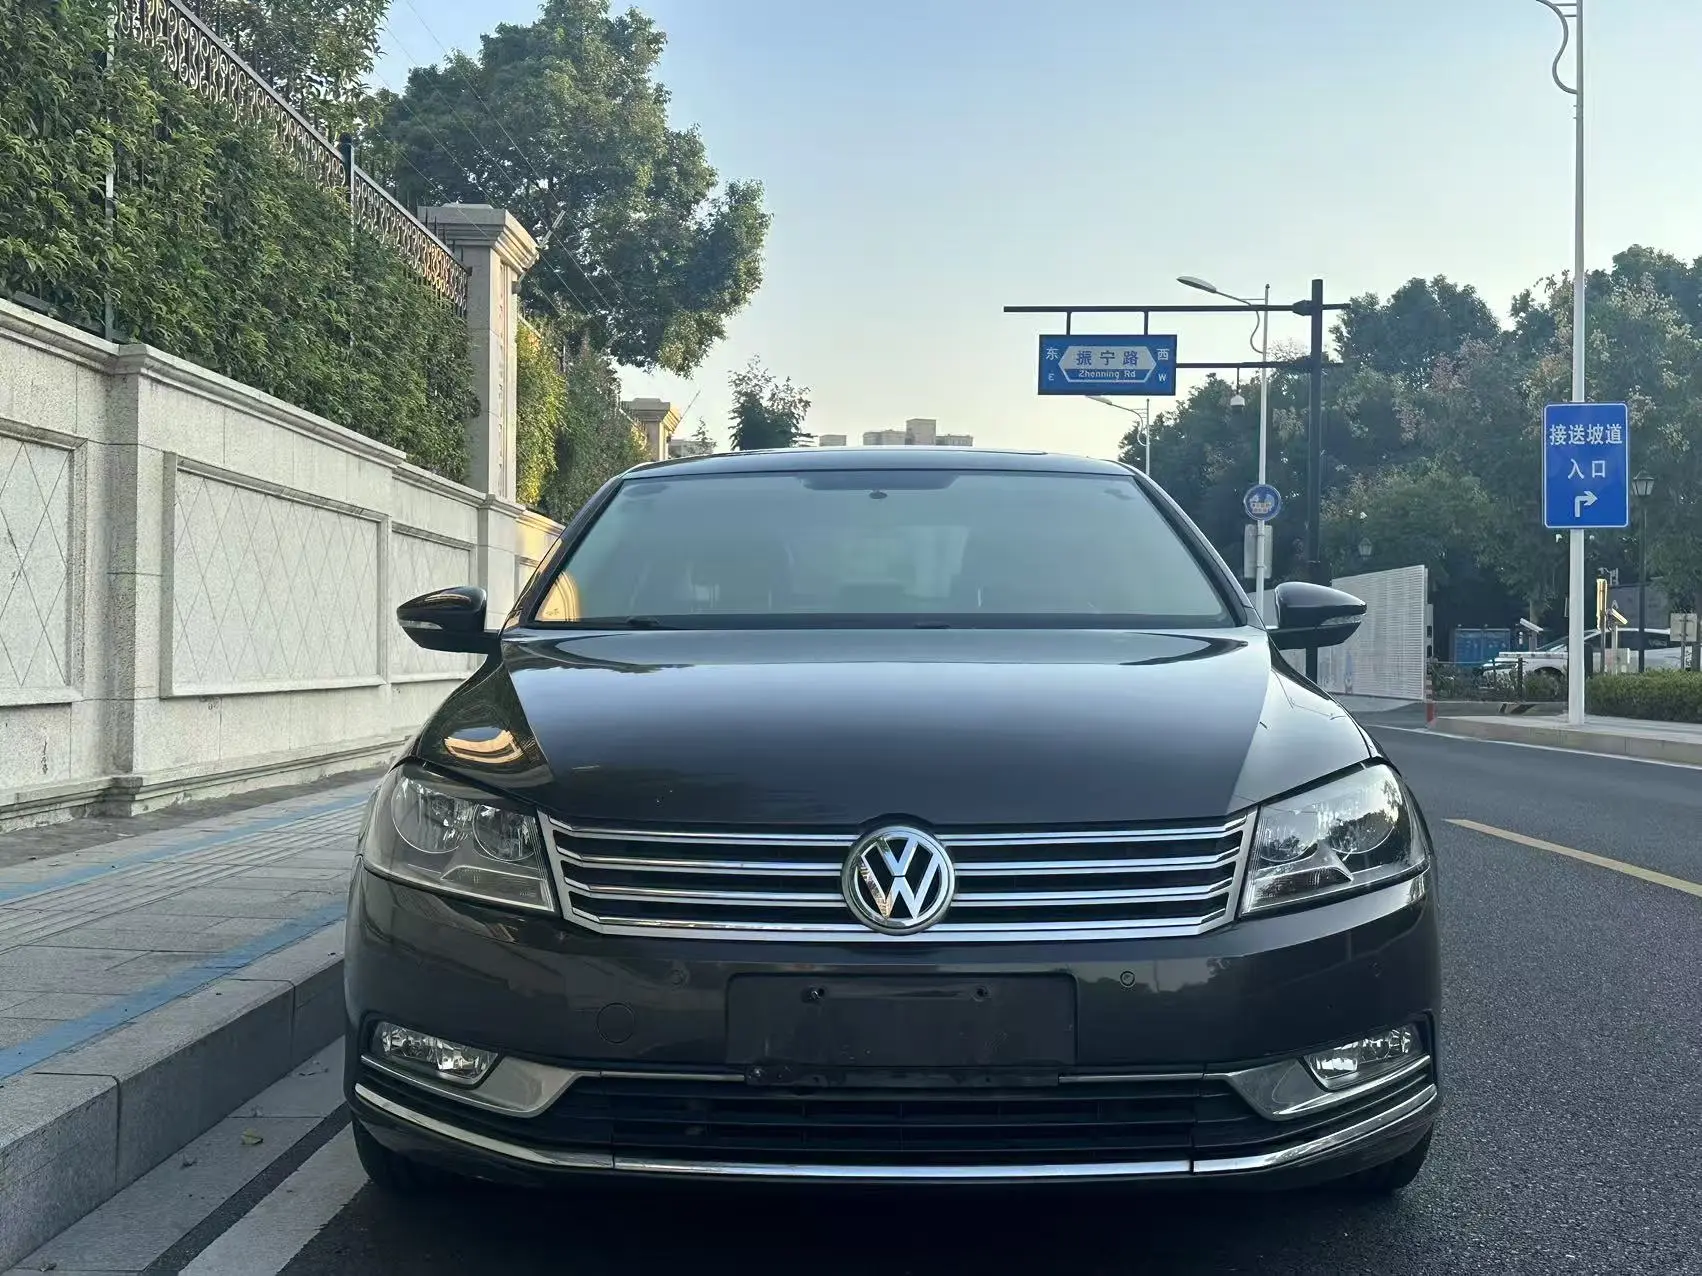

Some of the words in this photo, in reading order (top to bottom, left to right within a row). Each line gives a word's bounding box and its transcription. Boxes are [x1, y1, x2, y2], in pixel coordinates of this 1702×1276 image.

[1046, 348, 1059, 361] 东
[1076, 350, 1138, 366] 振宁路
[1156, 348, 1170, 361] 西
[1048, 373, 1055, 381] E
[1078, 370, 1120, 380] Zhenning
[1124, 369, 1136, 378] Rd
[1158, 373, 1167, 382] W
[1549, 424, 1623, 445] 接送坡道
[1567, 458, 1606, 480] 入口
